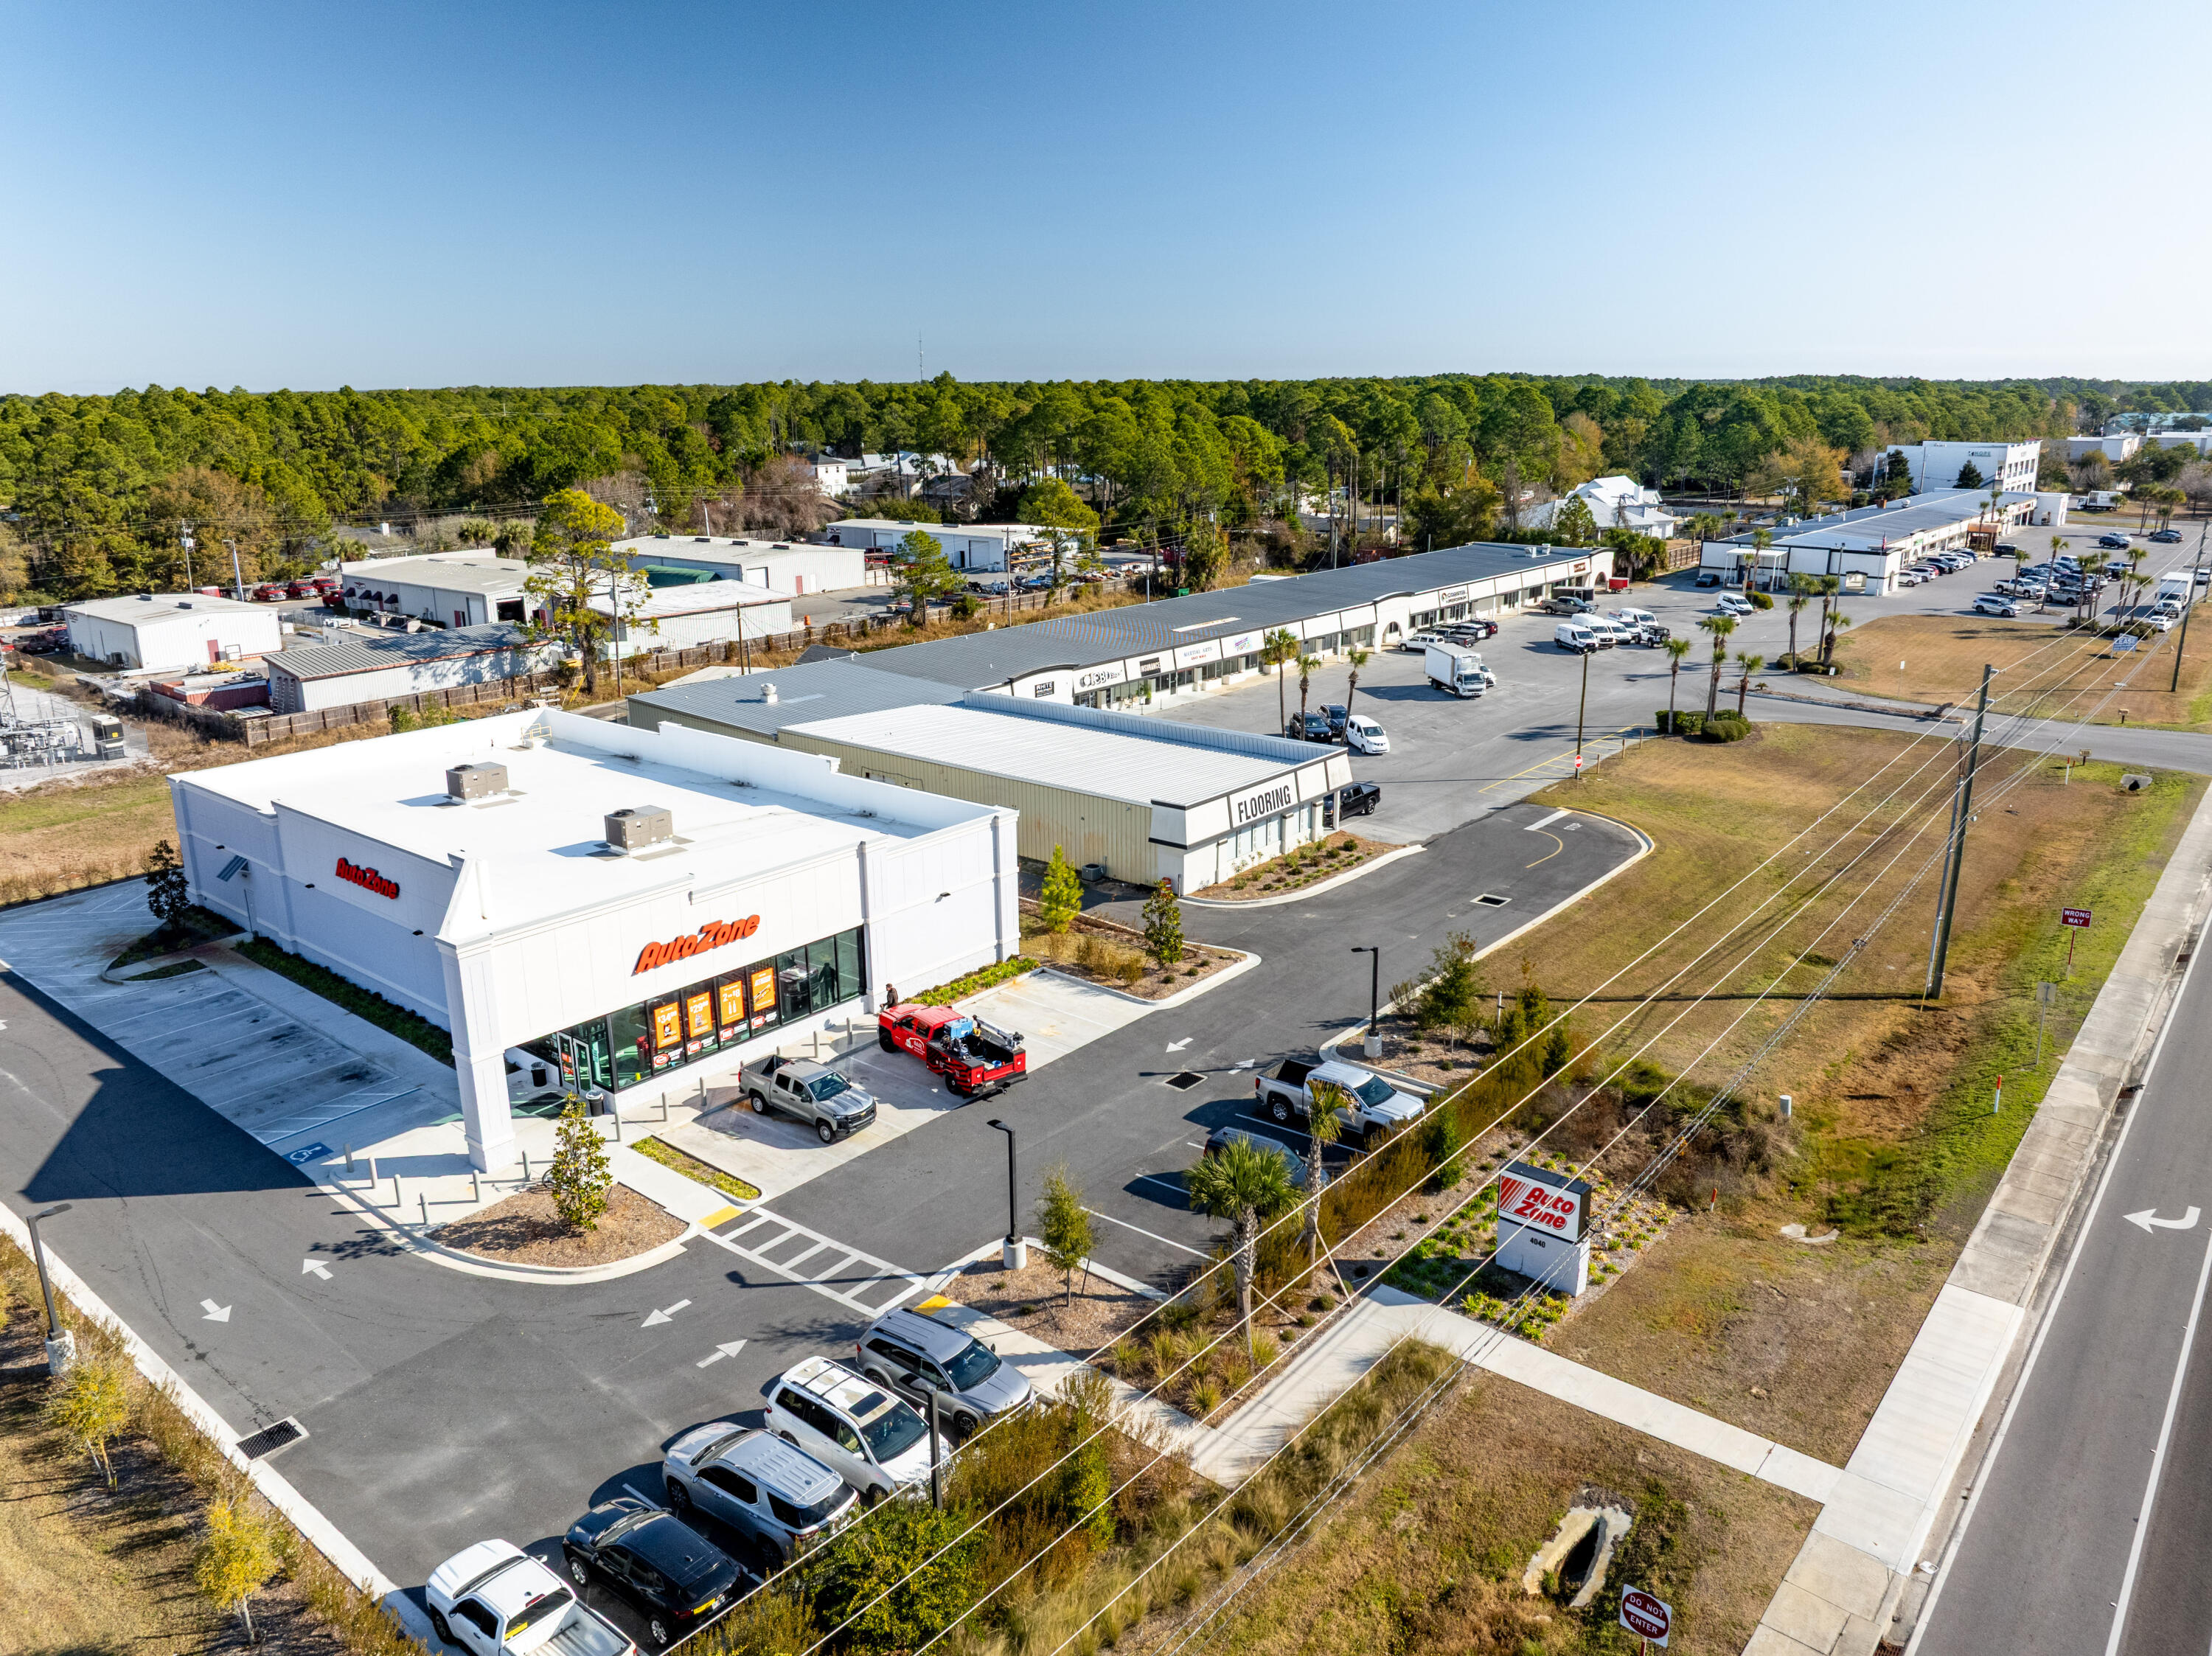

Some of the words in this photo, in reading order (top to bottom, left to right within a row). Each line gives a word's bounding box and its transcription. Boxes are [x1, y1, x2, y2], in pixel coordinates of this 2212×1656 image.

[1140, 662, 1161, 672] INSURANCE
[1036, 681, 1054, 691] WHITE
[1237, 784, 1291, 823] FLOORING
[335, 857, 400, 900] AutoZone
[2065, 910, 2090, 919] WRONG
[633, 914, 760, 975] AutoZone
[1525, 1186, 1576, 1215] Auto
[1513, 1200, 1568, 1231] Zone
[1529, 1237, 1546, 1248] 4040
[1630, 1595, 1642, 1606] DO
[1646, 1603, 1664, 1617] NOT
[1630, 1615, 1658, 1635] ENTER
